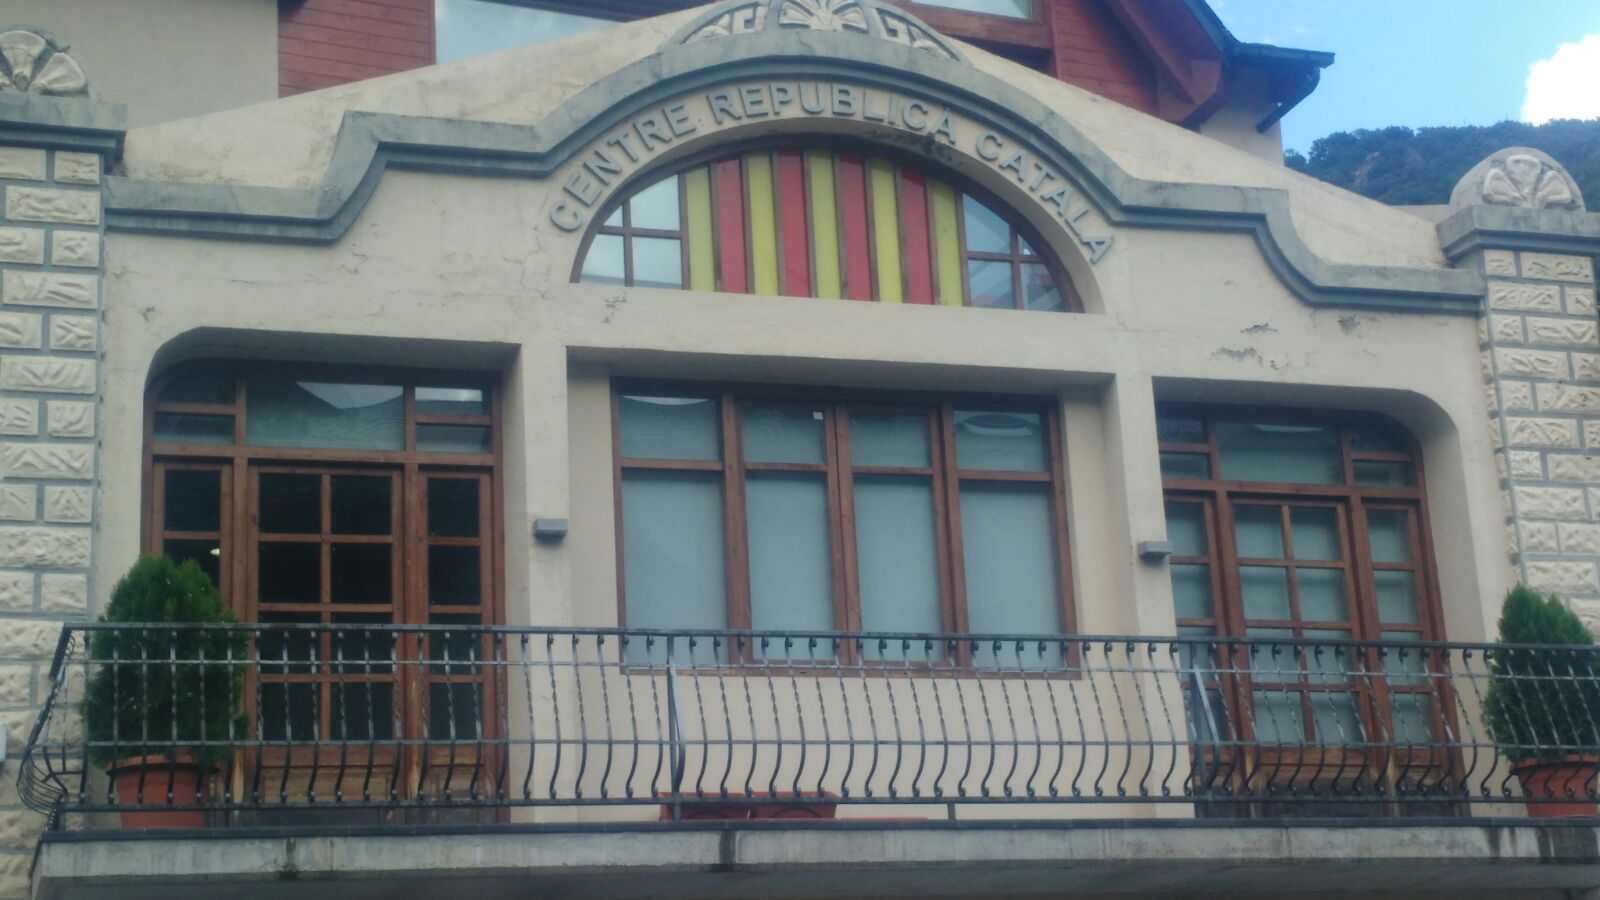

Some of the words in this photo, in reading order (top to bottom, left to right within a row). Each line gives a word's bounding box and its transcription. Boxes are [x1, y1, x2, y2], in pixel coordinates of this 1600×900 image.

[550, 103, 697, 233] CENTRE
[706, 82, 957, 145] REPUBLICA
[975, 129, 1114, 265] CATALA
